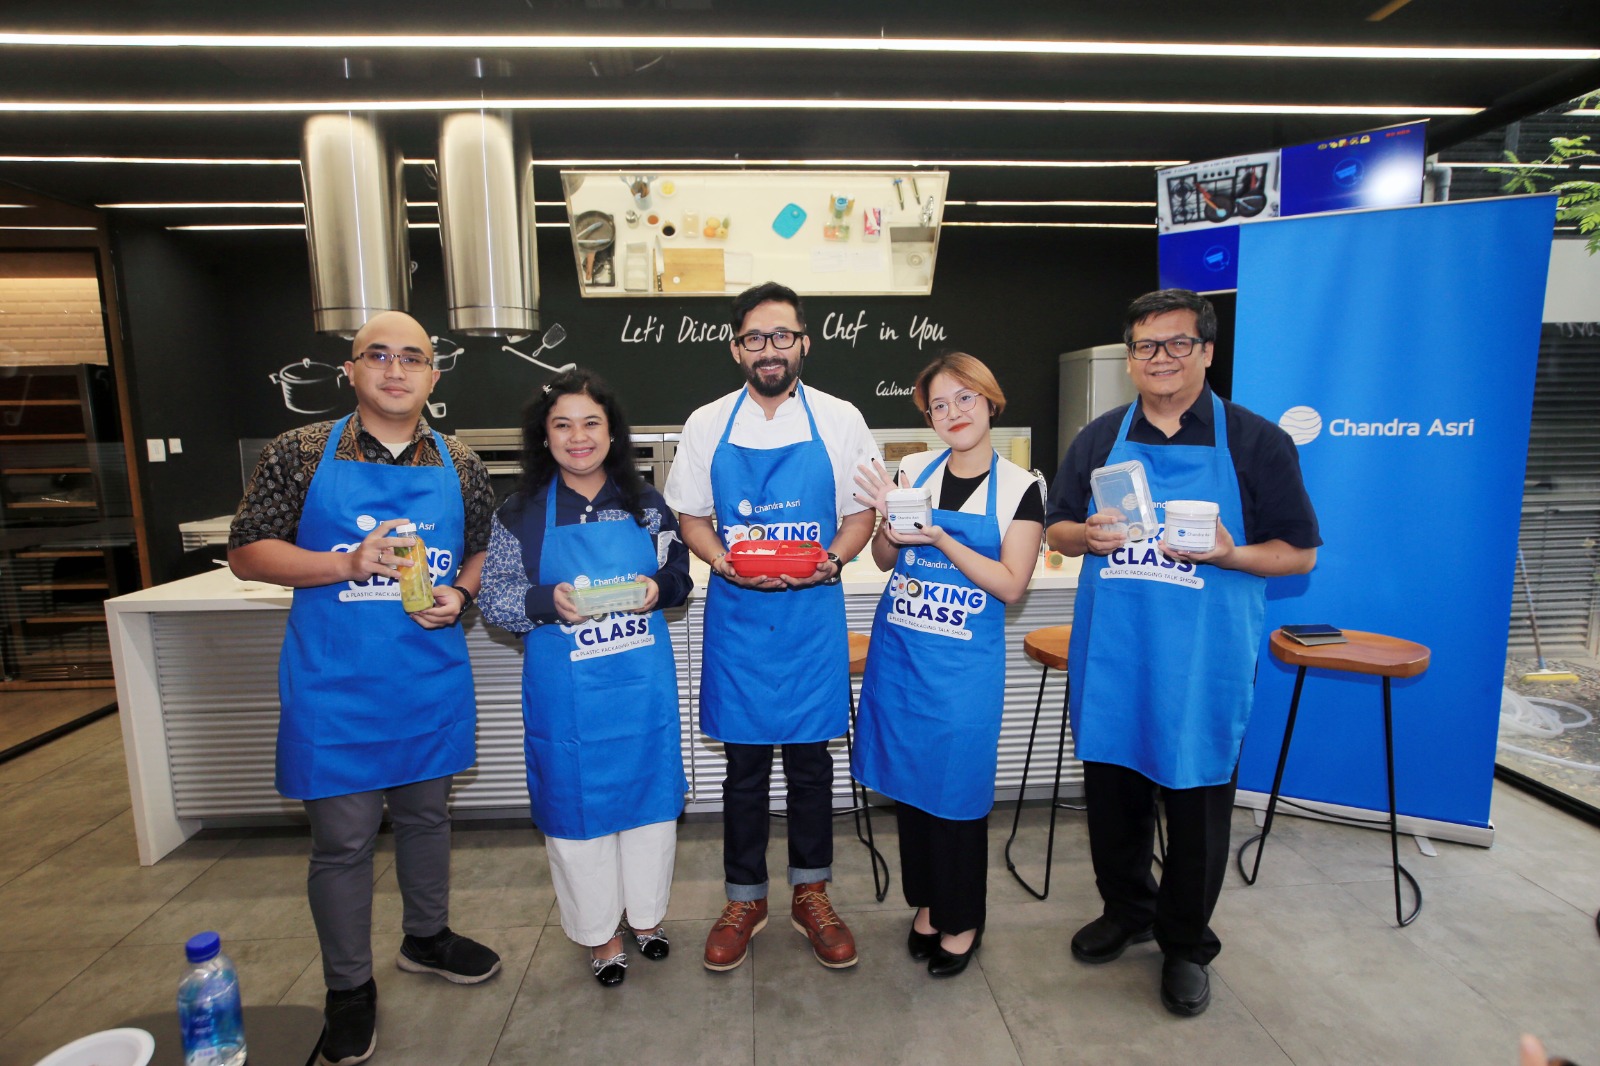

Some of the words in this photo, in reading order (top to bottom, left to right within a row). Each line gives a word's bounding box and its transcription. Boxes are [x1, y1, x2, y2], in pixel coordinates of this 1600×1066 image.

[621, 315, 665, 343] Let's
[822, 310, 868, 348] Chef
[879, 322, 899, 340] in
[909, 315, 947, 350] You
[1329, 418, 1420, 436] Chandra
[1427, 418, 1475, 436] Asri
[755, 501, 784, 514] Chandra
[917, 558, 947, 569] Chandra
[593, 576, 625, 587] Chandra
[1180, 577, 1198, 585] SHOW
[896, 598, 965, 626] CLASS
[579, 618, 647, 646] CLASS
